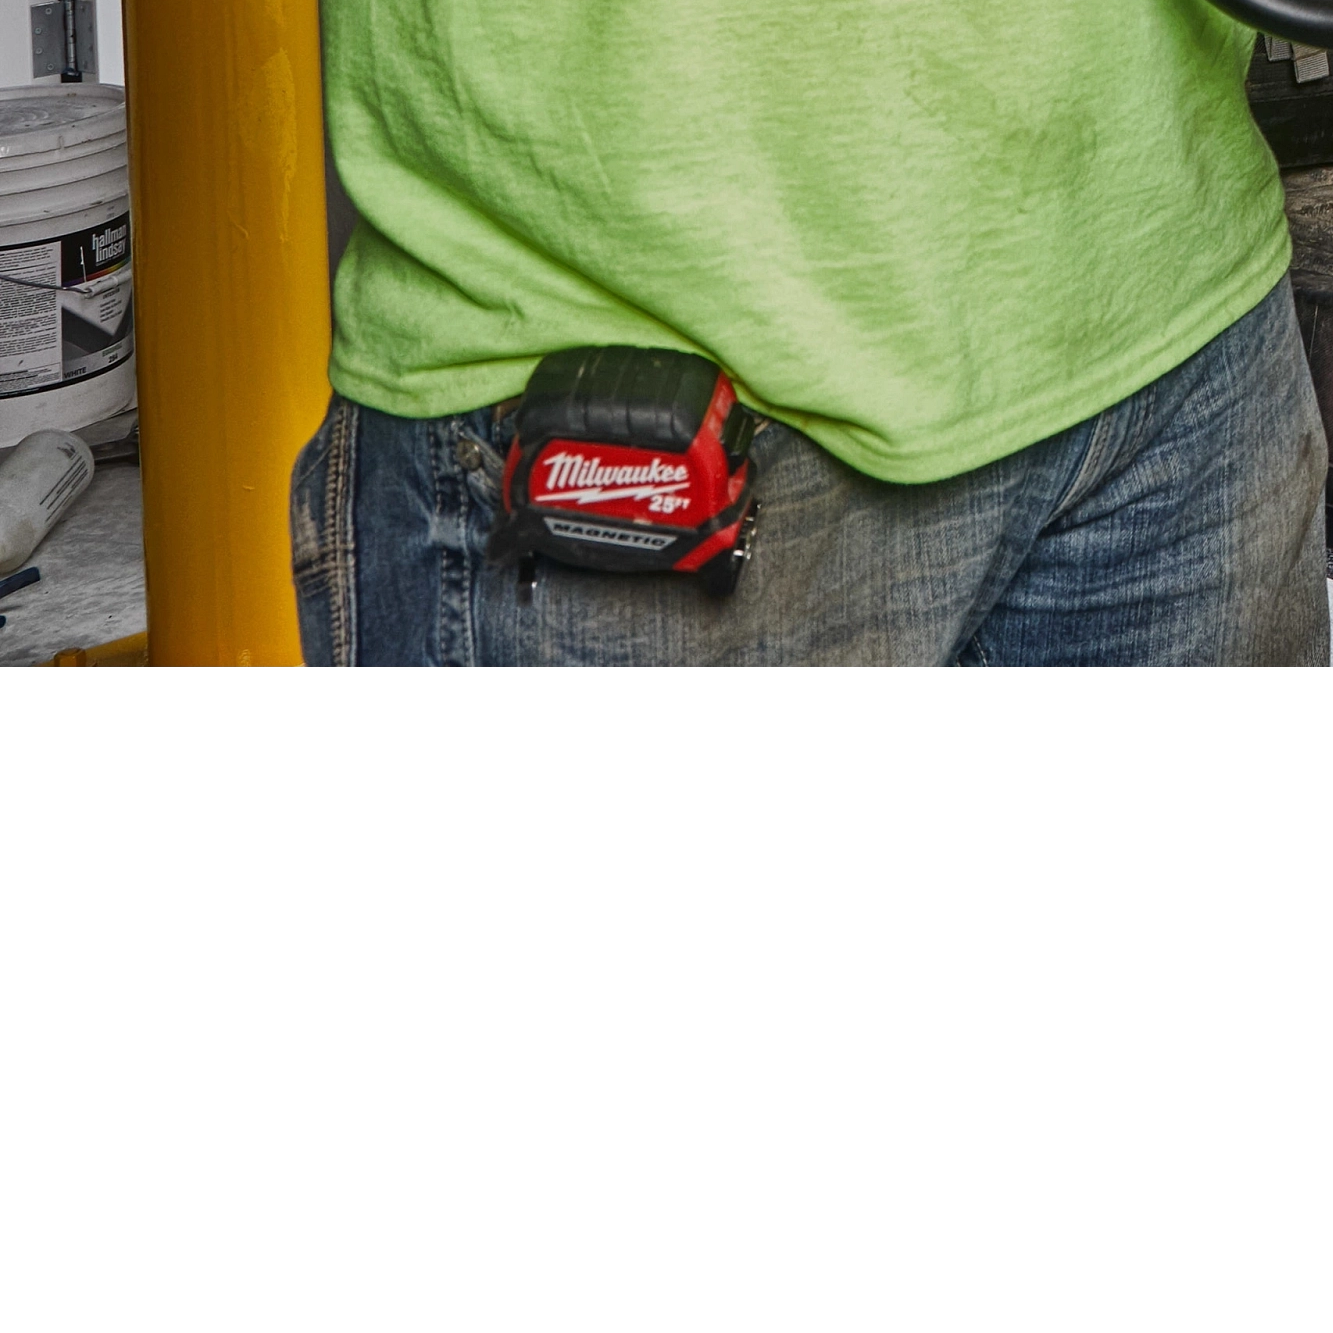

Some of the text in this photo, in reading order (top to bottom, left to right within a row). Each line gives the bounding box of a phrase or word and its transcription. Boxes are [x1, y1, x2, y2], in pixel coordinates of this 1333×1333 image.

[92, 224, 127, 251] hallman
[95, 241, 126, 264] lindsay
[63, 366, 87, 380] WHITE
[543, 451, 690, 491] Milwaukee
[553, 523, 668, 548] MAGNETIC
